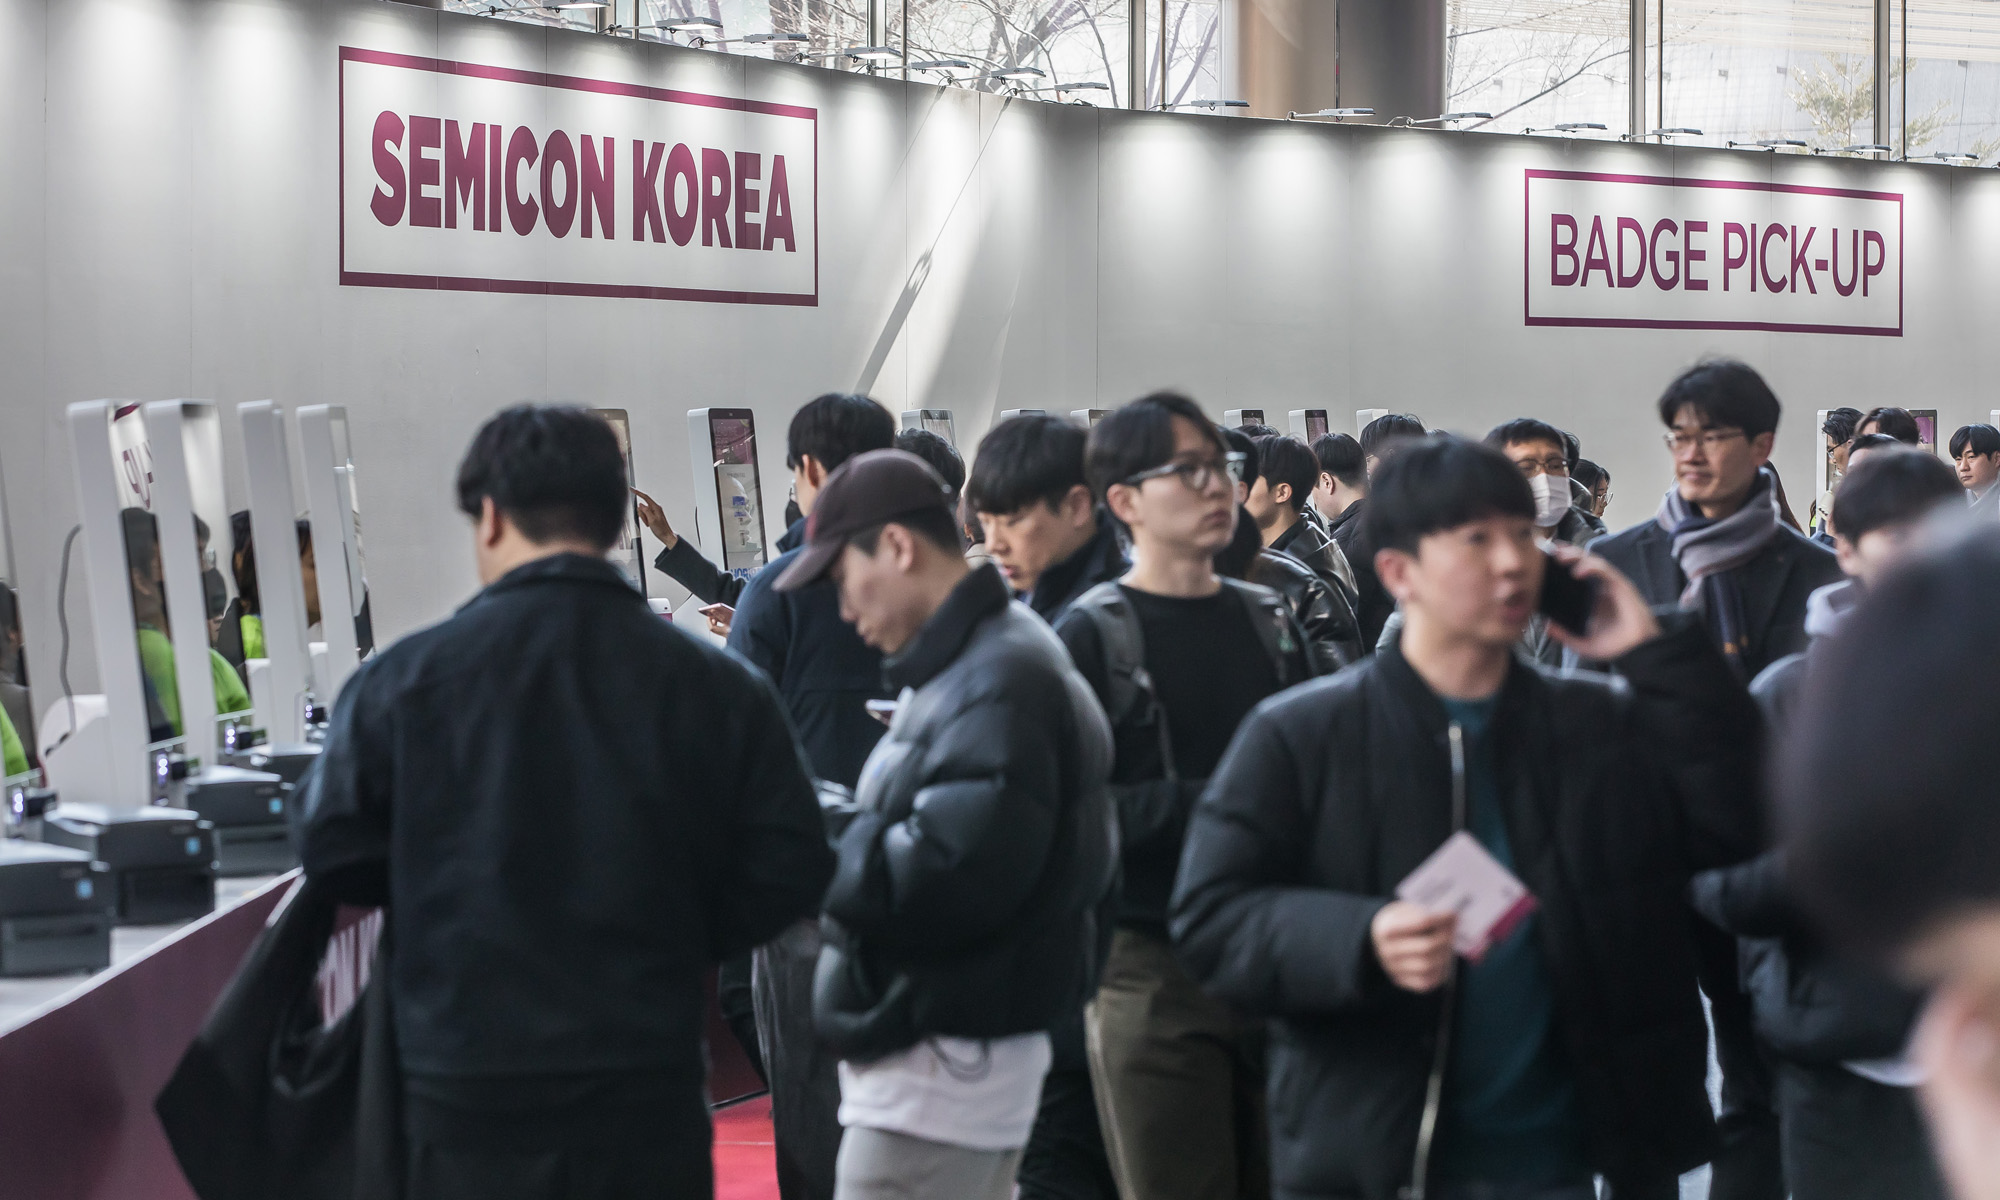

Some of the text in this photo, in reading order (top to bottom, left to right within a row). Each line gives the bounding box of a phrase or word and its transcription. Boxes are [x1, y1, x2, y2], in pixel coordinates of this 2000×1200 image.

[370, 110, 797, 253] SEMICON KOREA
[1551, 213, 1885, 297] BADGE PICK-UP
